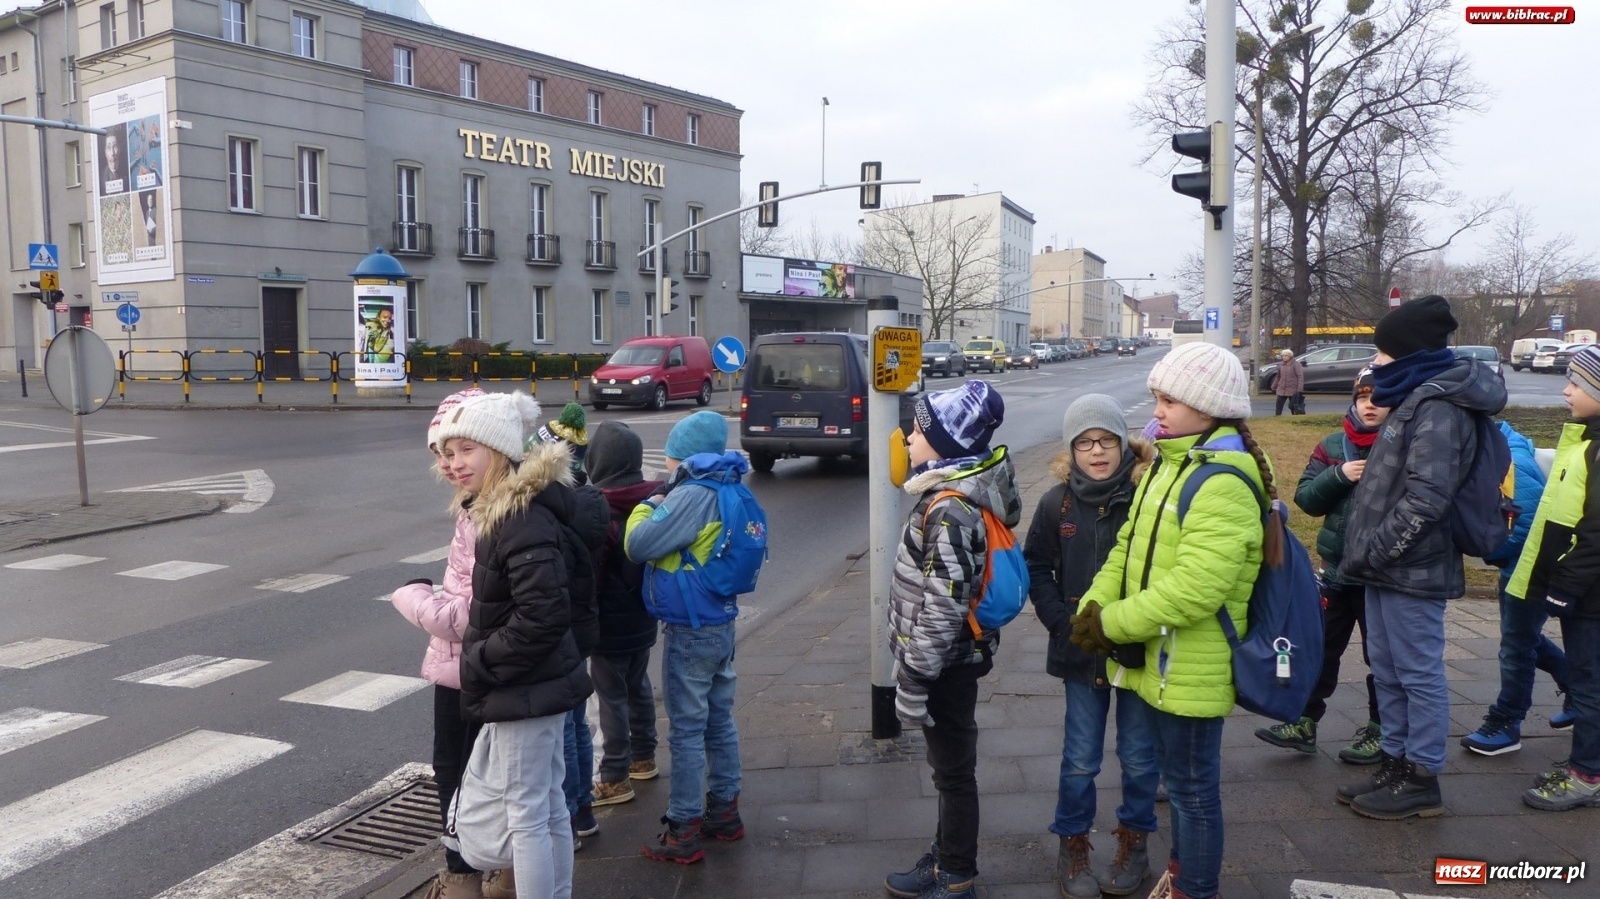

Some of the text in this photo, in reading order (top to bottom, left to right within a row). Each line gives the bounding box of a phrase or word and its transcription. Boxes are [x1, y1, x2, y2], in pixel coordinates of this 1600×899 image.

[458, 128, 666, 188] TEATR MIEJSKI
[878, 331, 912, 342] UWAGA
